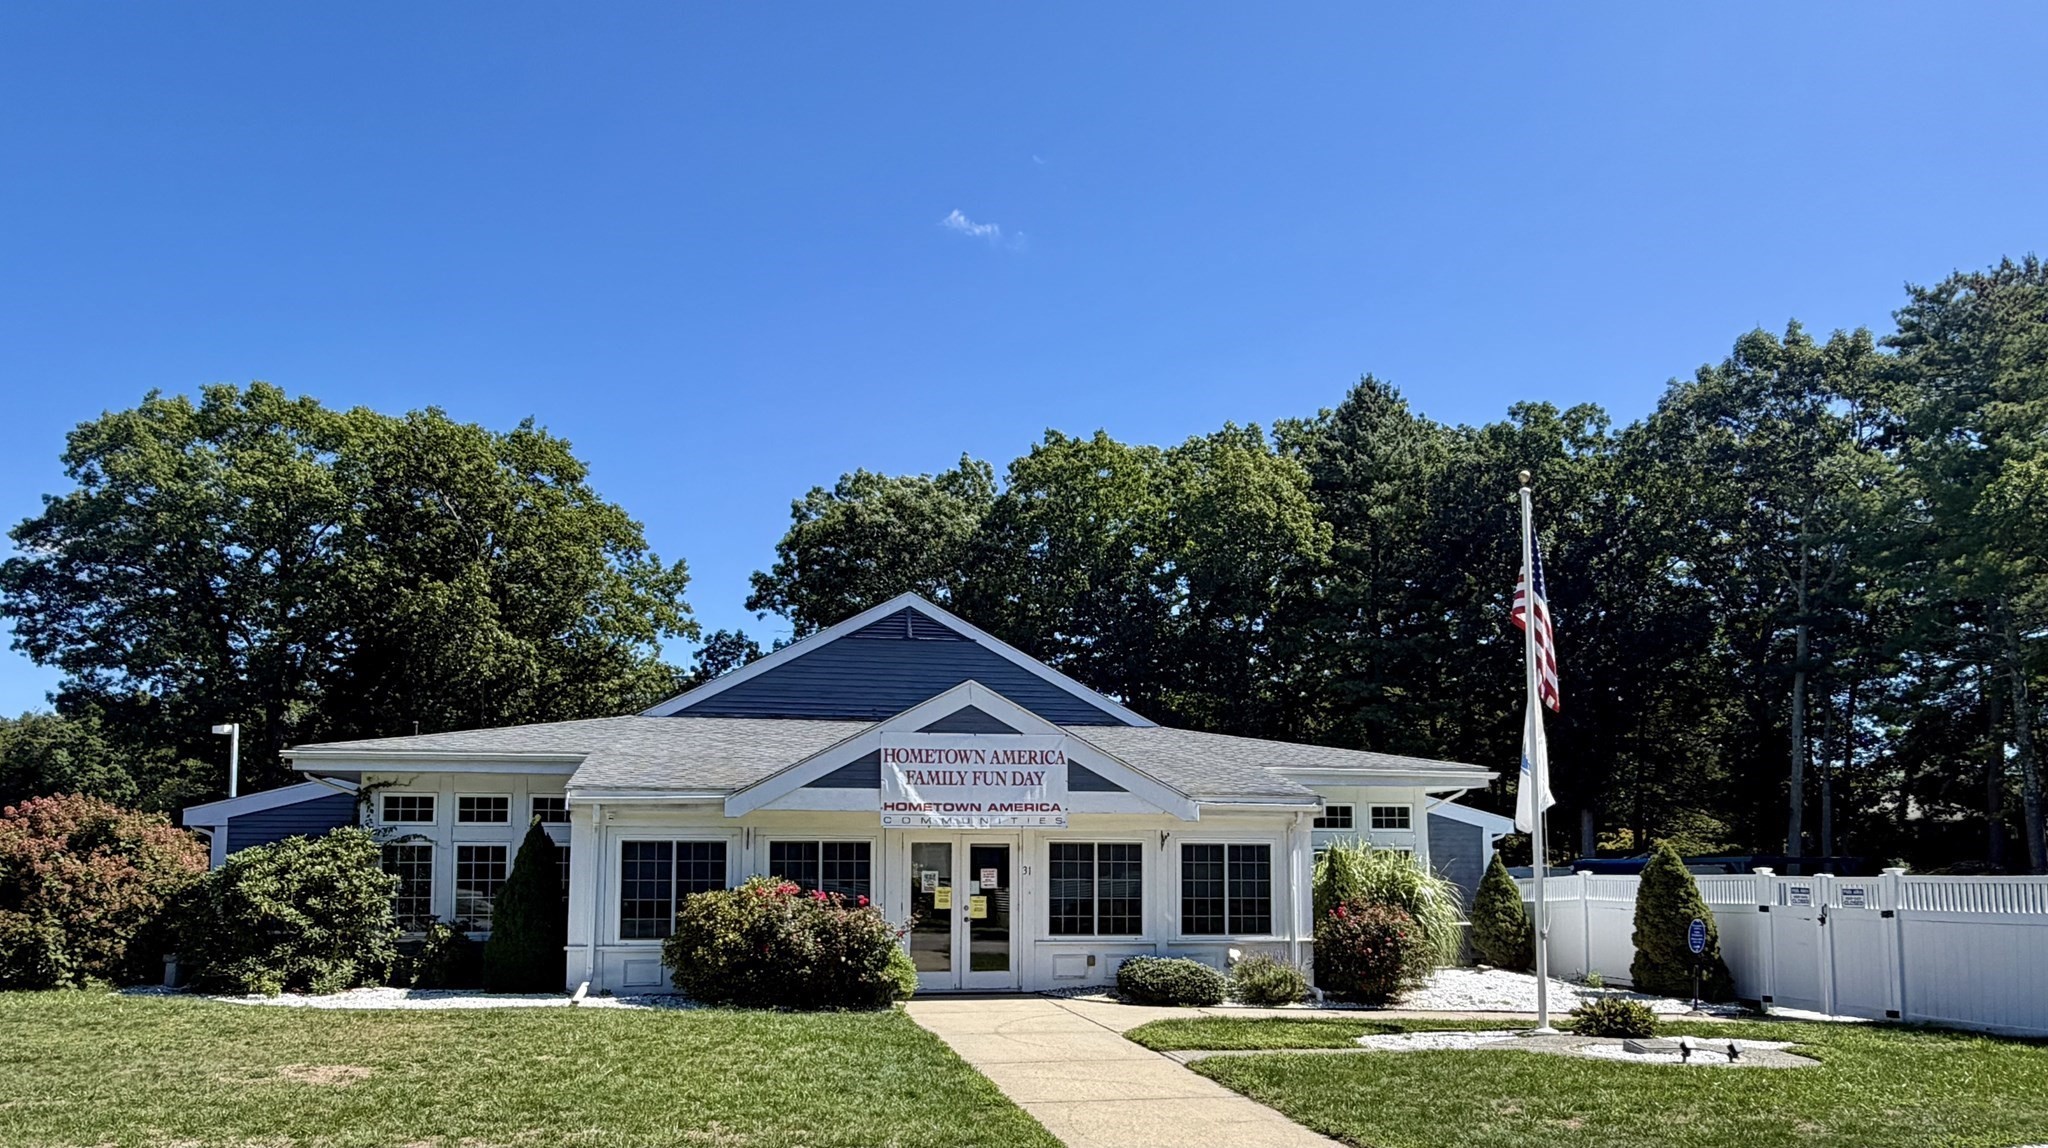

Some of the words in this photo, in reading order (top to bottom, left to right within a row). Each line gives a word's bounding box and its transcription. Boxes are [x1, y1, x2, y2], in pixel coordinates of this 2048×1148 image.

[884, 748, 985, 765] HOMETOWN
[990, 750, 1066, 765] AMERICA
[906, 770, 968, 786] FAMILY
[972, 771, 1007, 786] FUN
[1011, 771, 1046, 786] DAY
[884, 802, 982, 812] HOMETOWN
[988, 803, 1061, 812] AMERICA
[883, 816, 1064, 825] COMMUNITIES
[1022, 866, 1031, 876] 31
